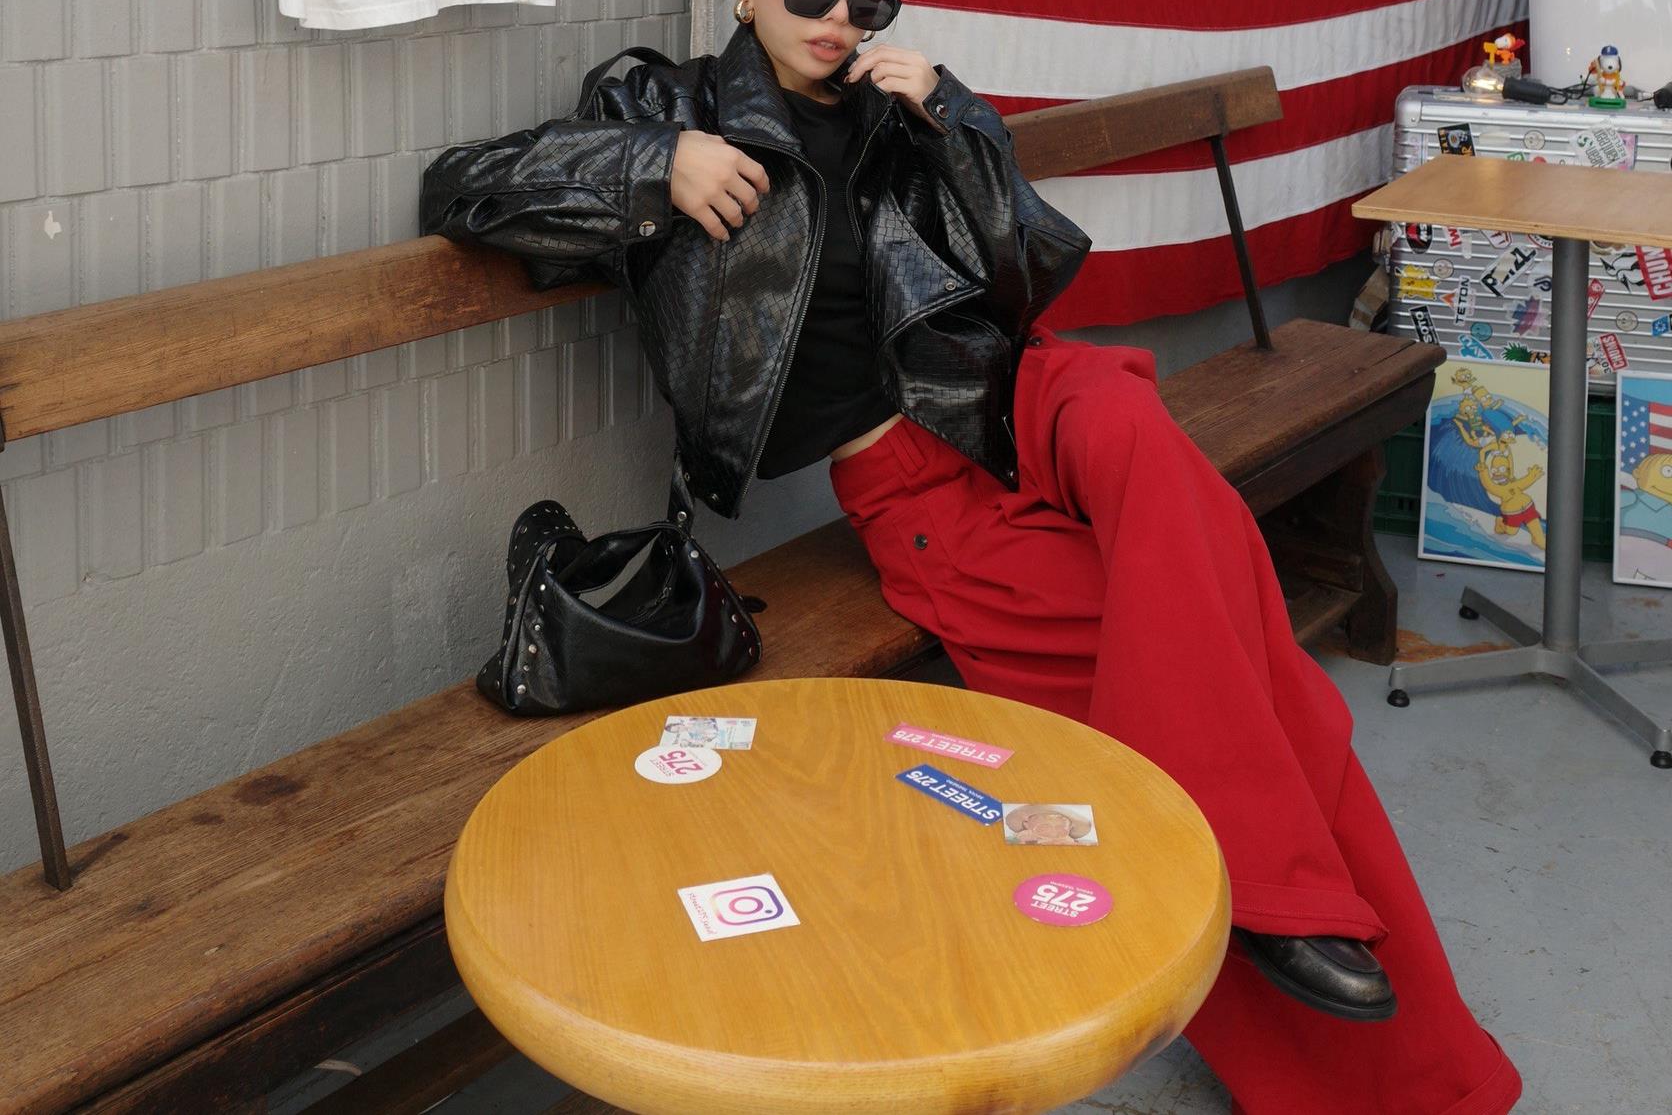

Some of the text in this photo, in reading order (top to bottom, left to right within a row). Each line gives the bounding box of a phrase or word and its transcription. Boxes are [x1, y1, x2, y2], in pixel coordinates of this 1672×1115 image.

[1456, 278, 1470, 324] TETON
[1416, 311, 1432, 343] SOTO
[1603, 334, 1625, 367] CHUMS
[892, 730, 925, 744] 275
[658, 750, 703, 775] 275
[921, 739, 1002, 764] STREET
[905, 770, 938, 787] 275
[930, 778, 1001, 820] STREET
[1031, 900, 1080, 918] STREET
[1032, 884, 1097, 912] 275
